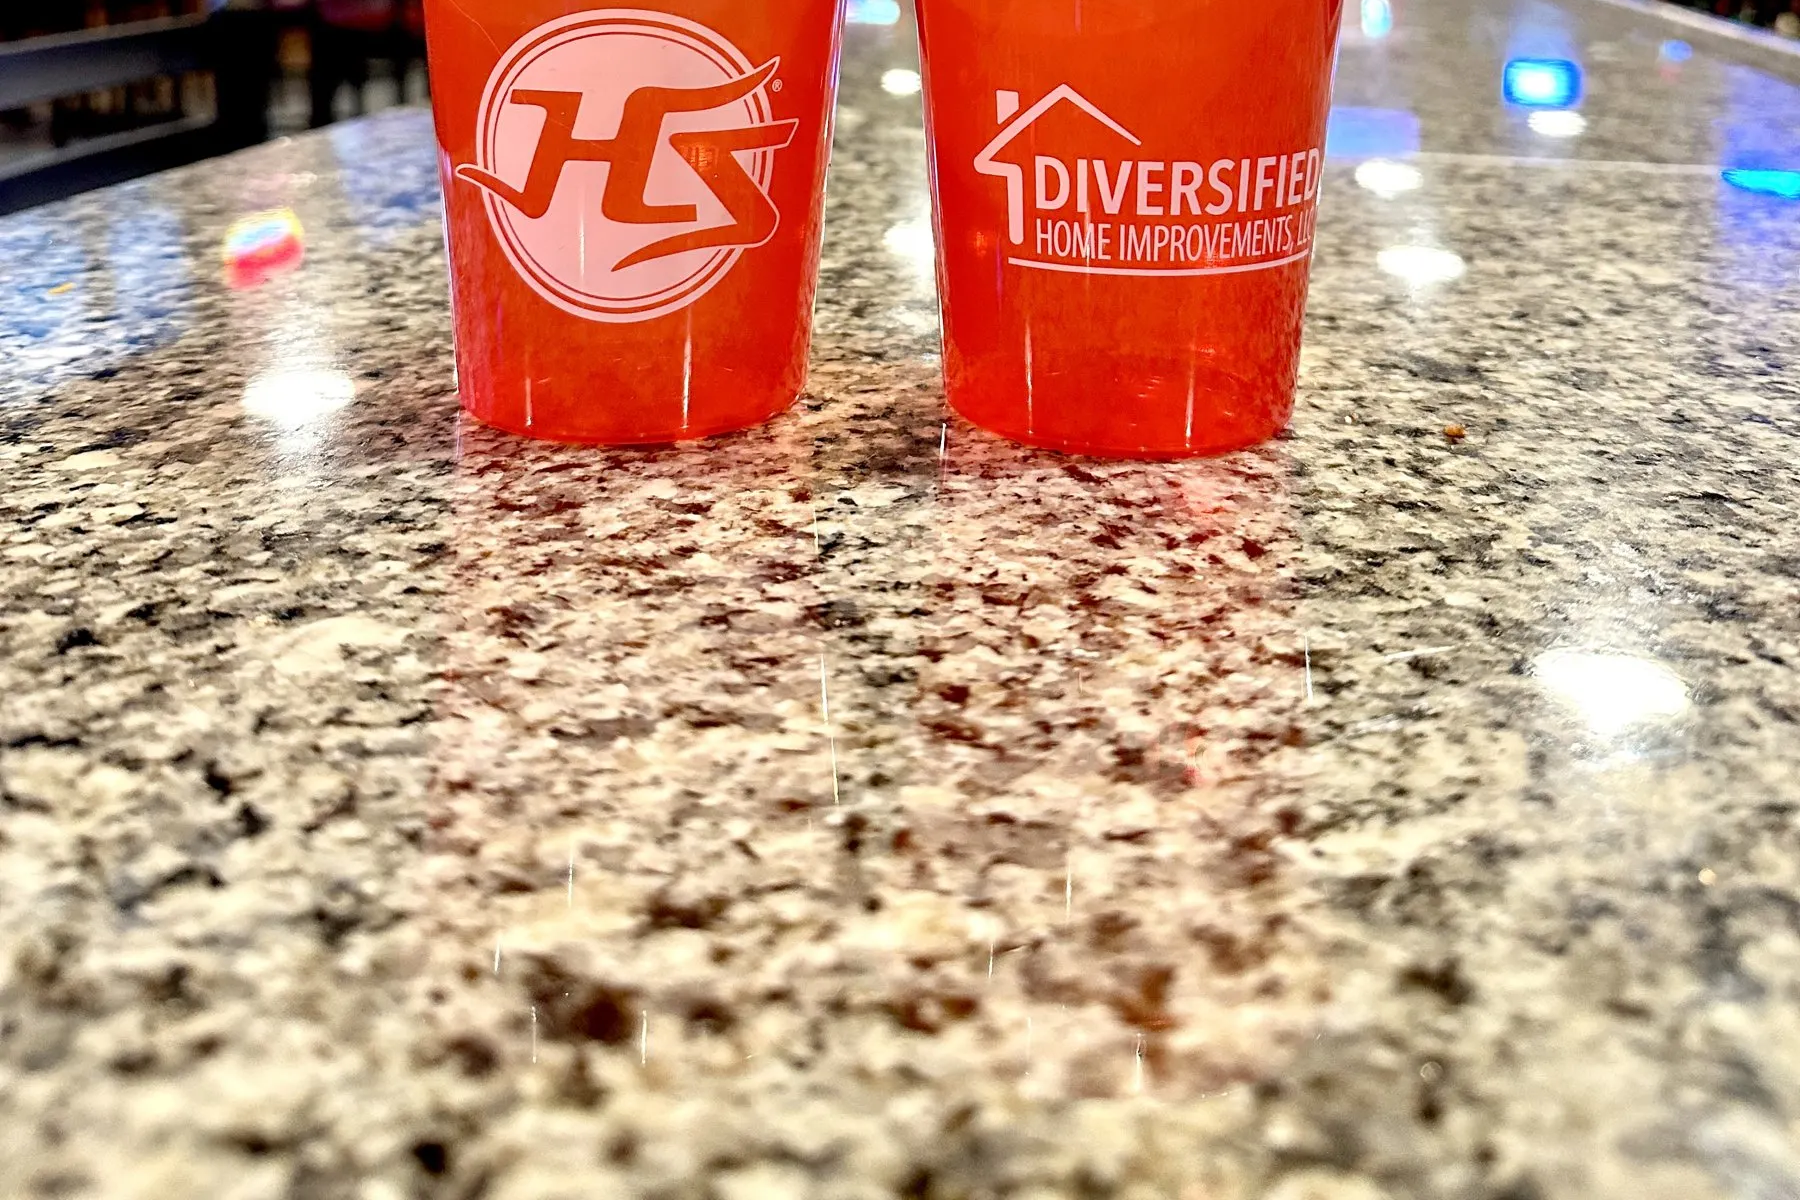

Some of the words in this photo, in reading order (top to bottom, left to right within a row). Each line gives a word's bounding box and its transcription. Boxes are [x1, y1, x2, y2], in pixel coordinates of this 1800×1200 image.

[1034, 147, 1320, 216] DIVERSIFIED
[1036, 218, 1112, 261] HOME
[1119, 214, 1294, 262] IMPROVEMENTS,
